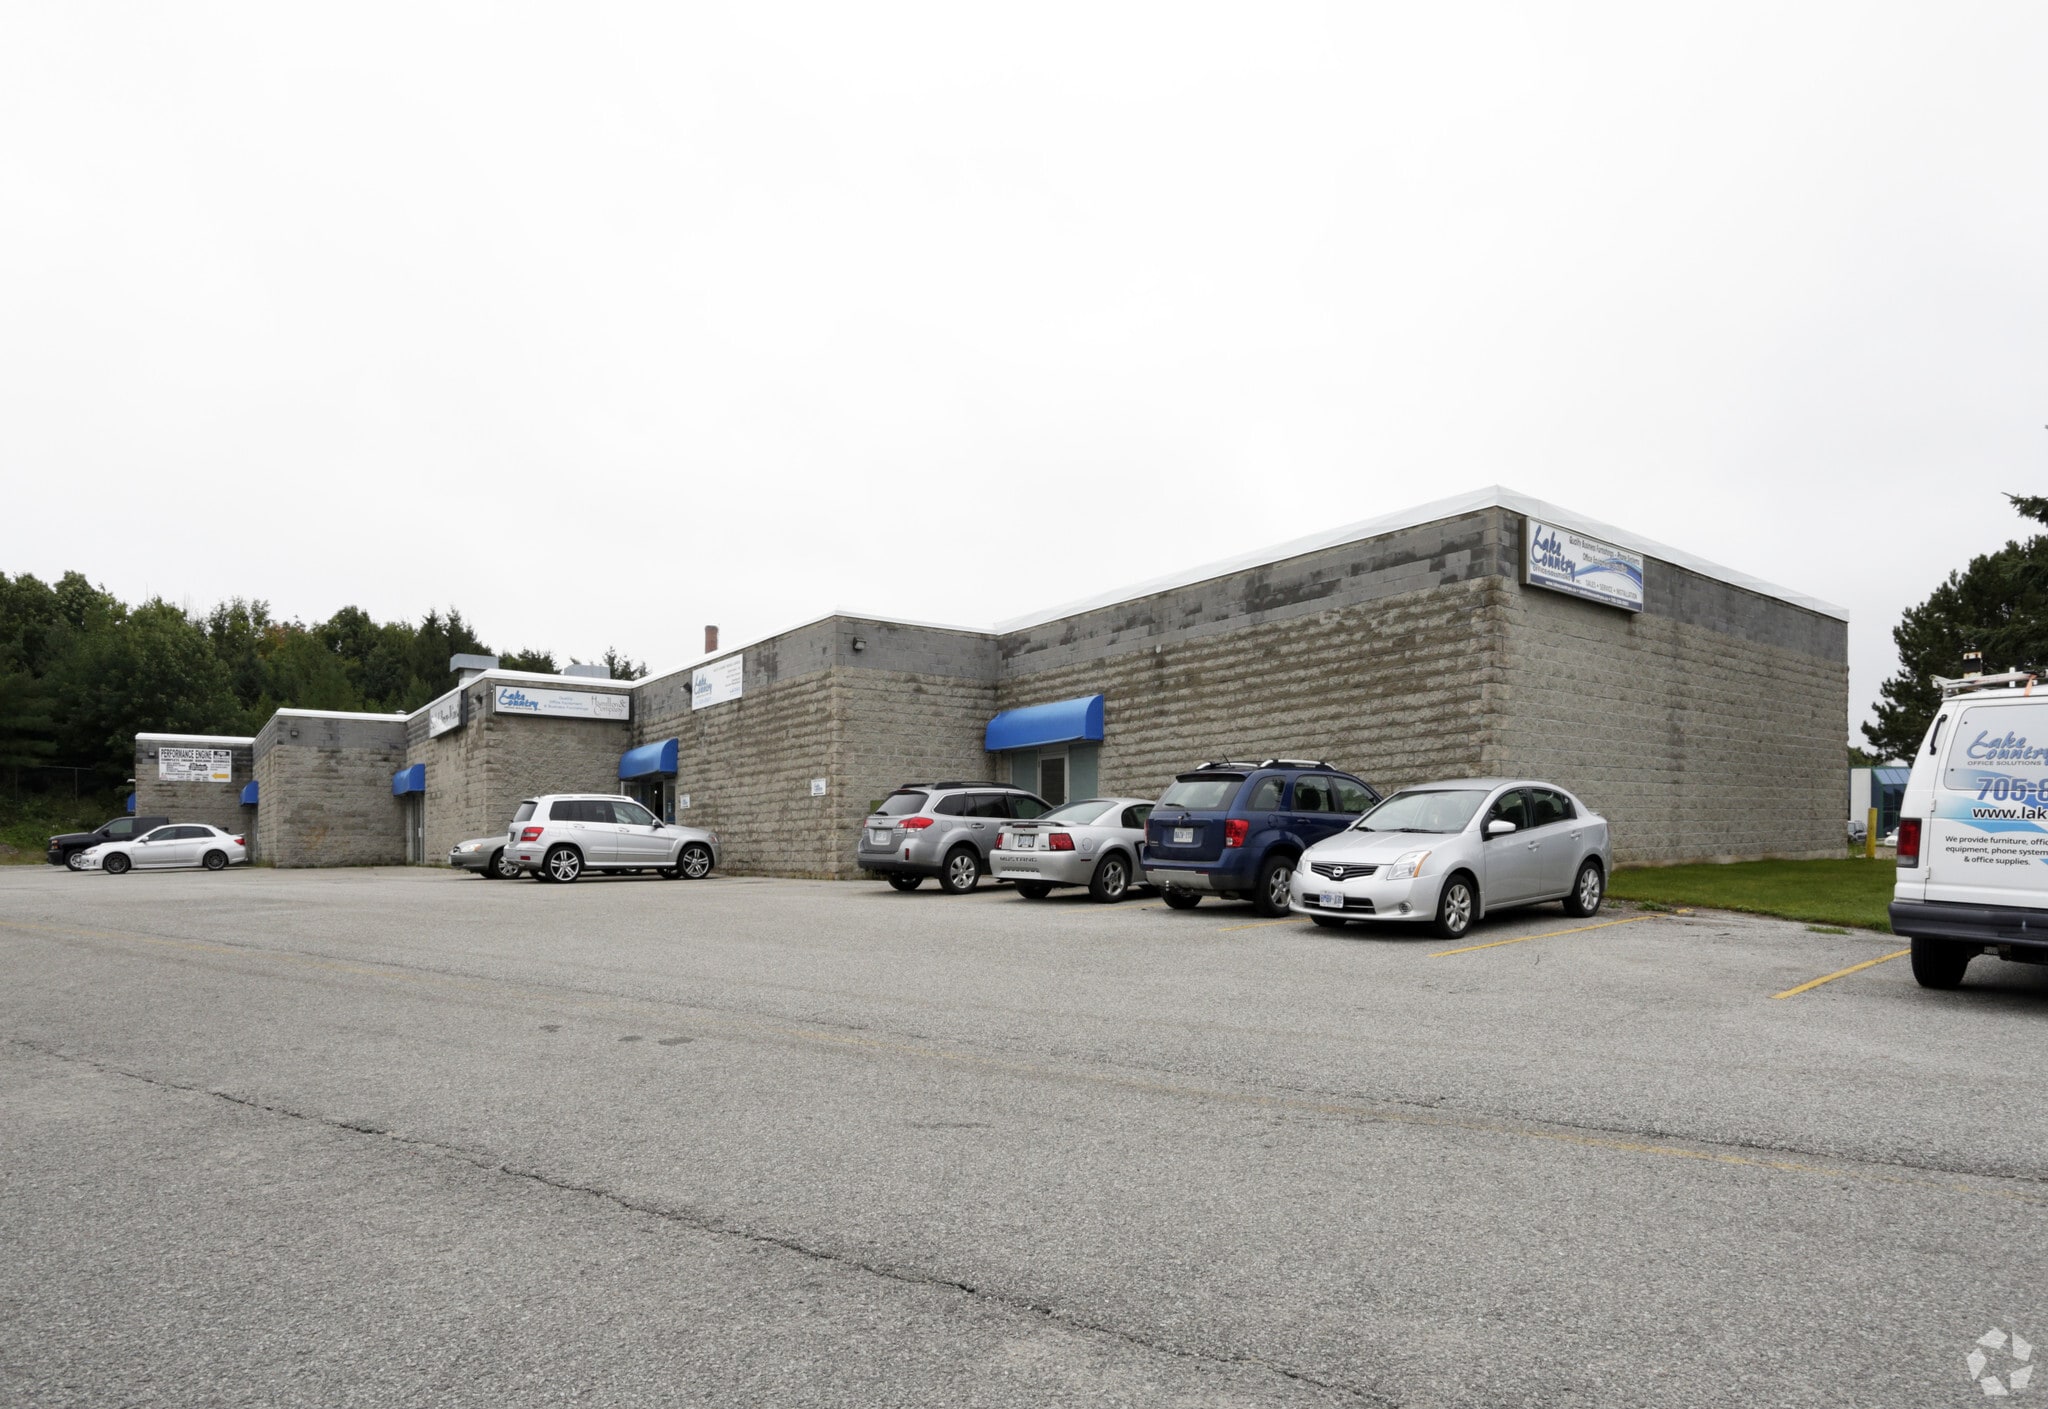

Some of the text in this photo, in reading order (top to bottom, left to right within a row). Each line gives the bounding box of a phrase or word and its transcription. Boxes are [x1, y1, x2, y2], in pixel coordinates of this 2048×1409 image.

[1533, 524, 1561, 556] Lake
[1532, 544, 1576, 582] Country
[500, 688, 525, 700] Lake
[498, 696, 539, 711] Country
[1969, 730, 2027, 748] Lake
[161, 748, 194, 759] PERFORMANCE
[195, 750, 212, 759] ENGINE
[1960, 836, 1988, 844] provide
[1990, 837, 2029, 846] furniture,
[1945, 846, 1989, 854] equipment,
[1991, 847, 2017, 855] phone
[1995, 857, 2031, 866] supplies.
